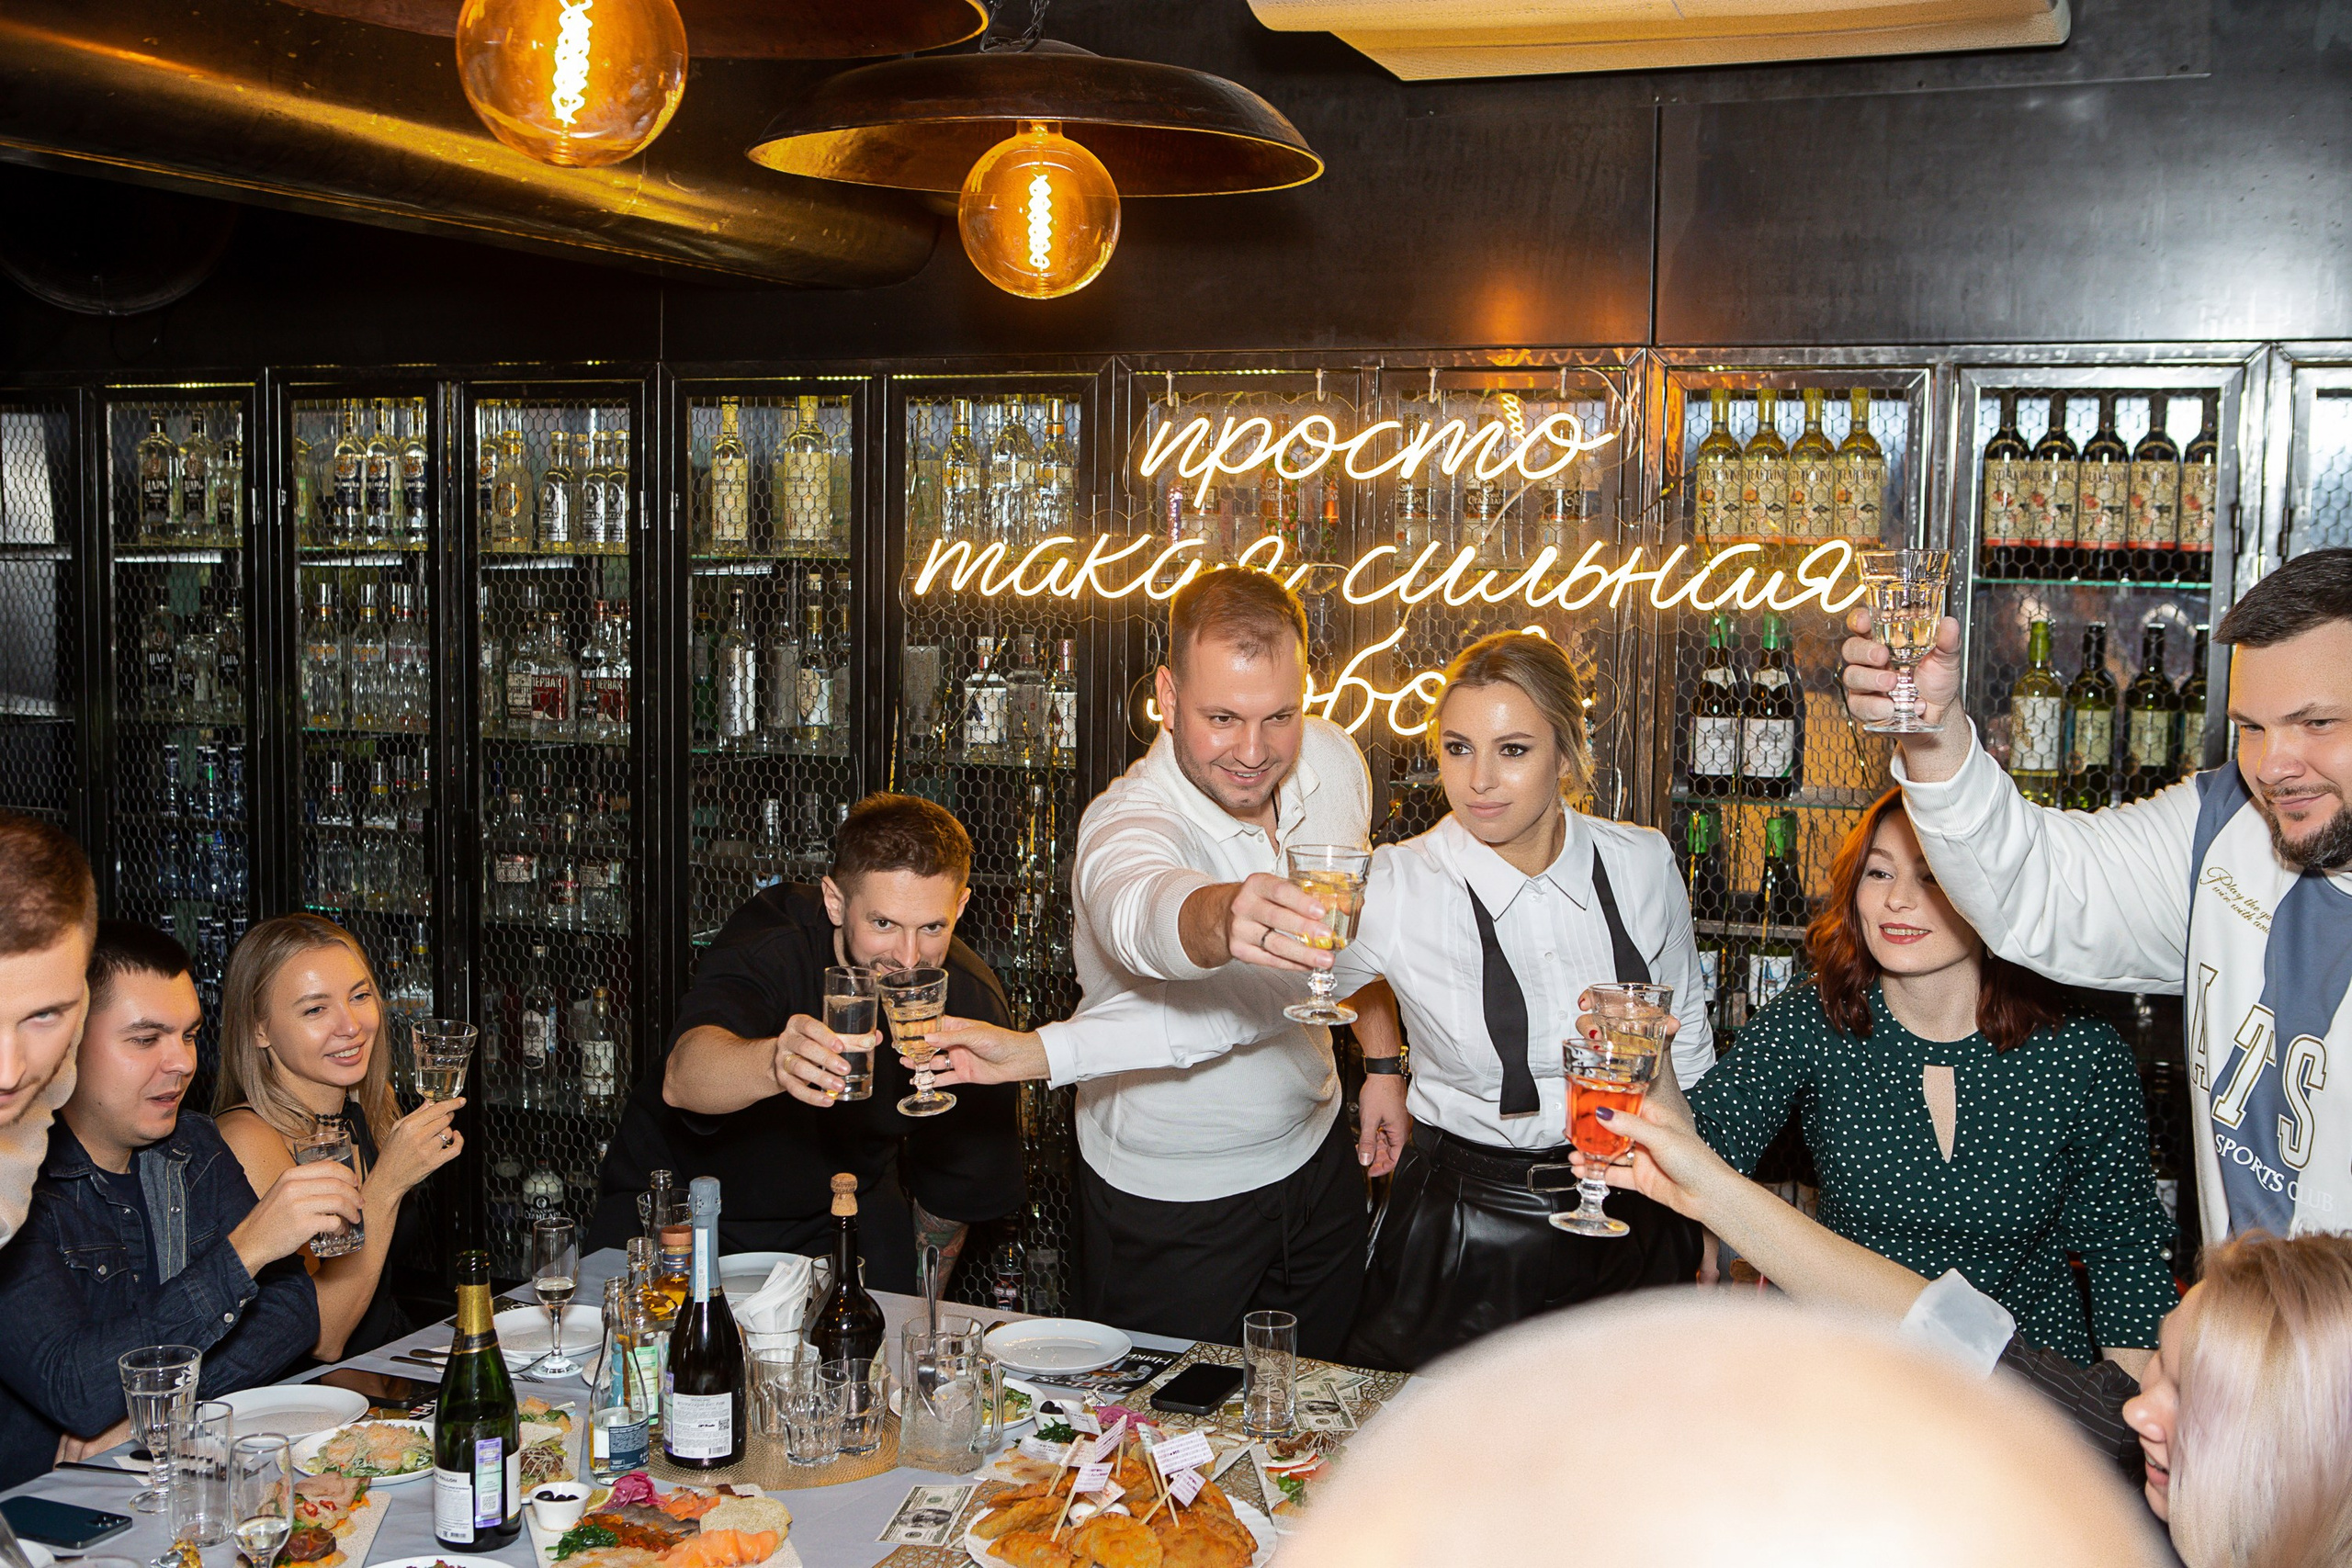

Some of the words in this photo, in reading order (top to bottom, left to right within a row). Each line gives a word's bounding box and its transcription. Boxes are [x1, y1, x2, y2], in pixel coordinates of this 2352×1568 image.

[1139, 412, 1615, 509] просто
[1341, 538, 1870, 614] сильная
[2199, 866, 2245, 901] Play
[2244, 897, 2260, 911] the
[2212, 886, 2231, 903] win
[2231, 904, 2253, 922] with
[2215, 1134, 2285, 1192] SPORTS
[2288, 1179, 2335, 1213] CLUB
